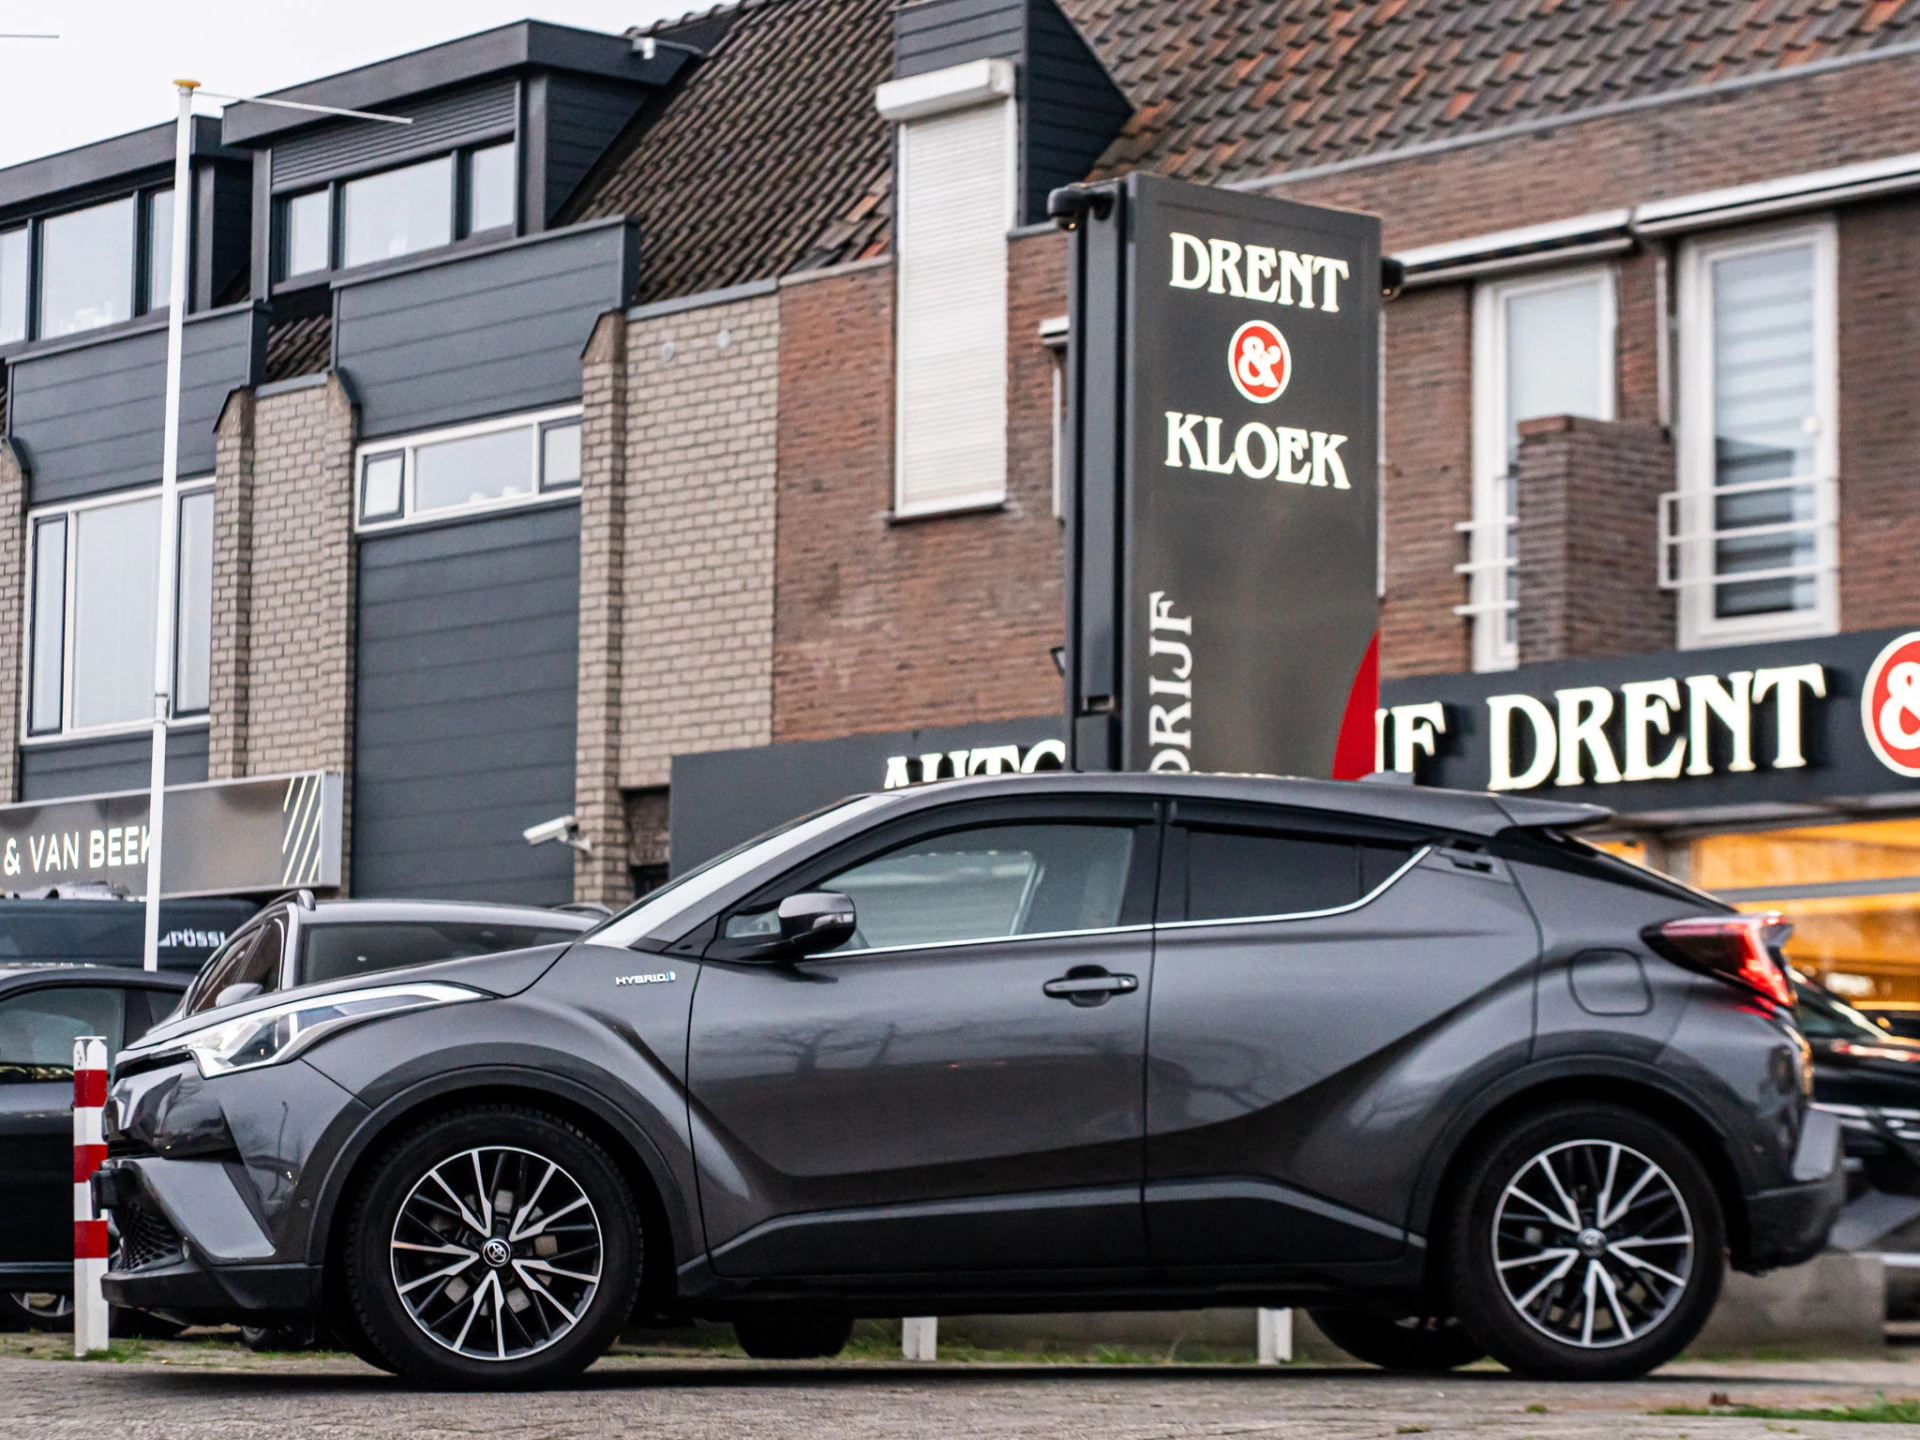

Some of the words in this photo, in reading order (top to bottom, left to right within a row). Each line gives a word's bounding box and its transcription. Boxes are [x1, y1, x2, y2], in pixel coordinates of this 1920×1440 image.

[1169, 232, 1350, 313] DRENT
[1237, 336, 1282, 388] &
[1165, 411, 1351, 489] KLOEK
[1486, 663, 1827, 791] DRENT
[3, 837, 21, 876] &
[29, 831, 80, 873] VAN
[615, 973, 667, 986] HYBRID
